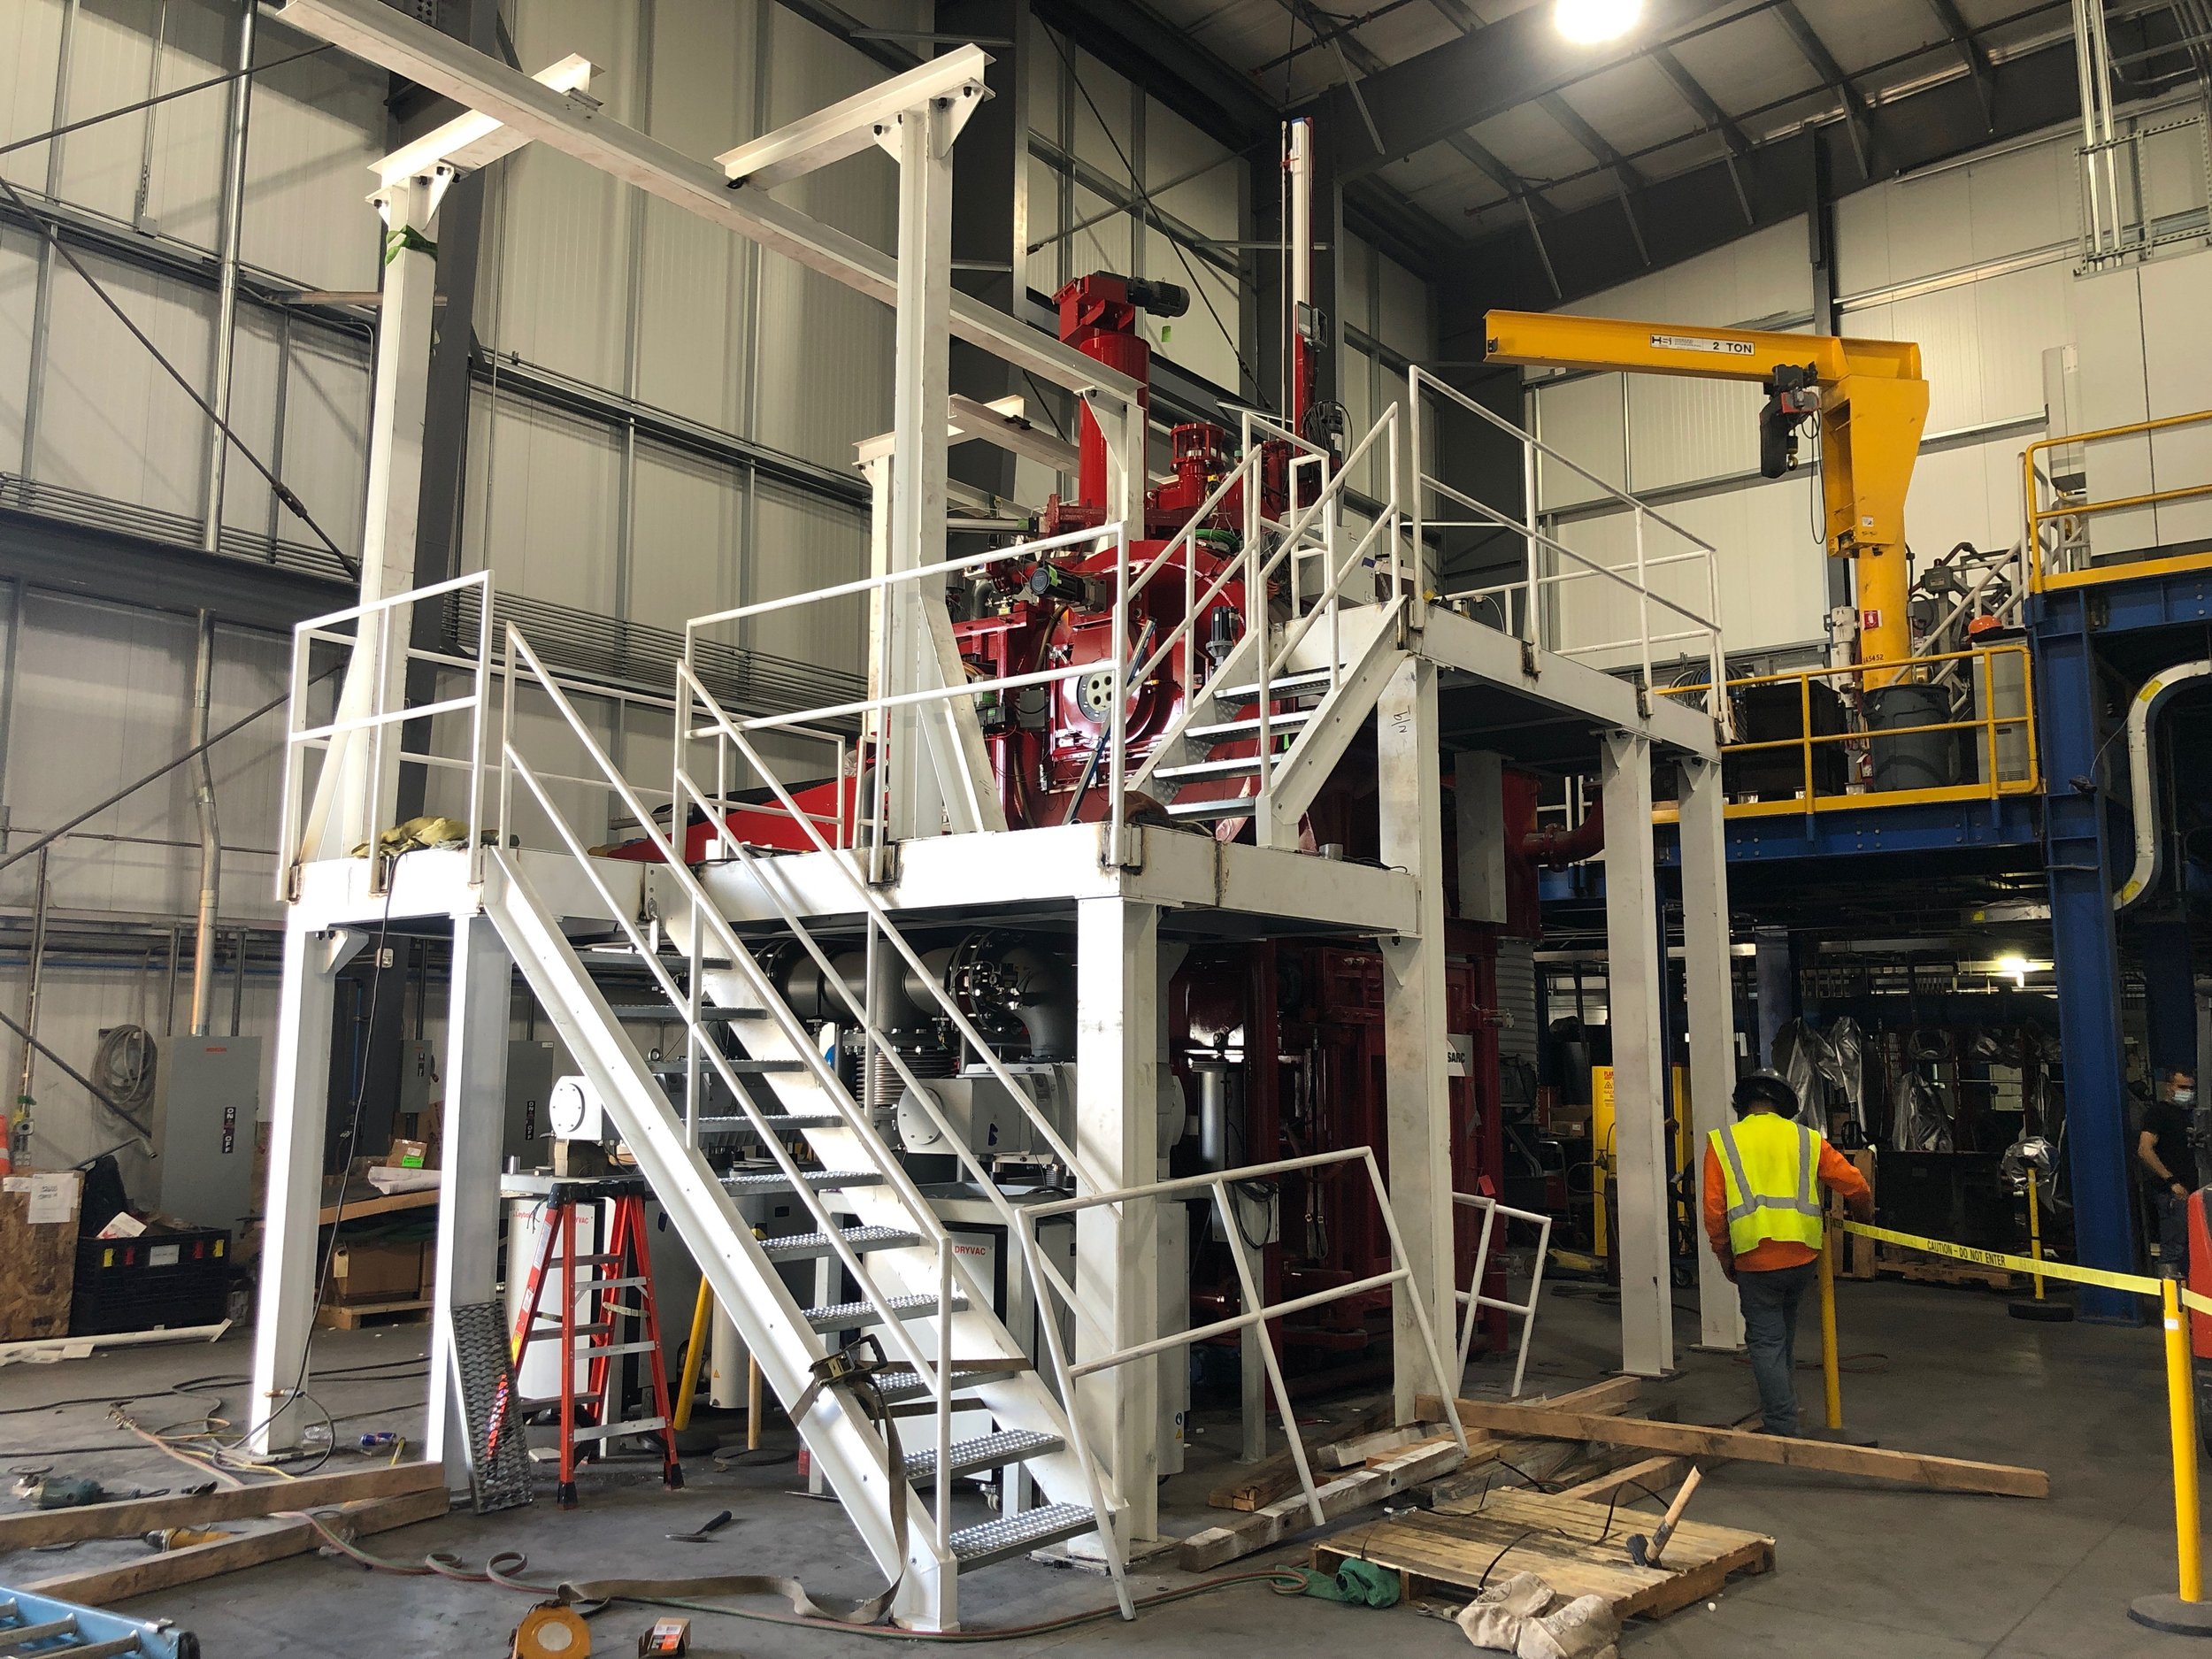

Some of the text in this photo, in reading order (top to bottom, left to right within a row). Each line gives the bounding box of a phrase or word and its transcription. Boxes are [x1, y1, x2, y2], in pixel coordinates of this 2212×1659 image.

[1713, 342, 1752, 353] 2 TON
[528, 1102, 534, 1111] ON
[227, 1108, 234, 1119] ON
[955, 1245, 986, 1256] DRYVAC
[1926, 1240, 1953, 1256] CAUTION
[1959, 1247, 1969, 1258] DO
[1970, 1248, 1983, 1262] NOT
[1985, 1253, 2006, 1266] ENTER
